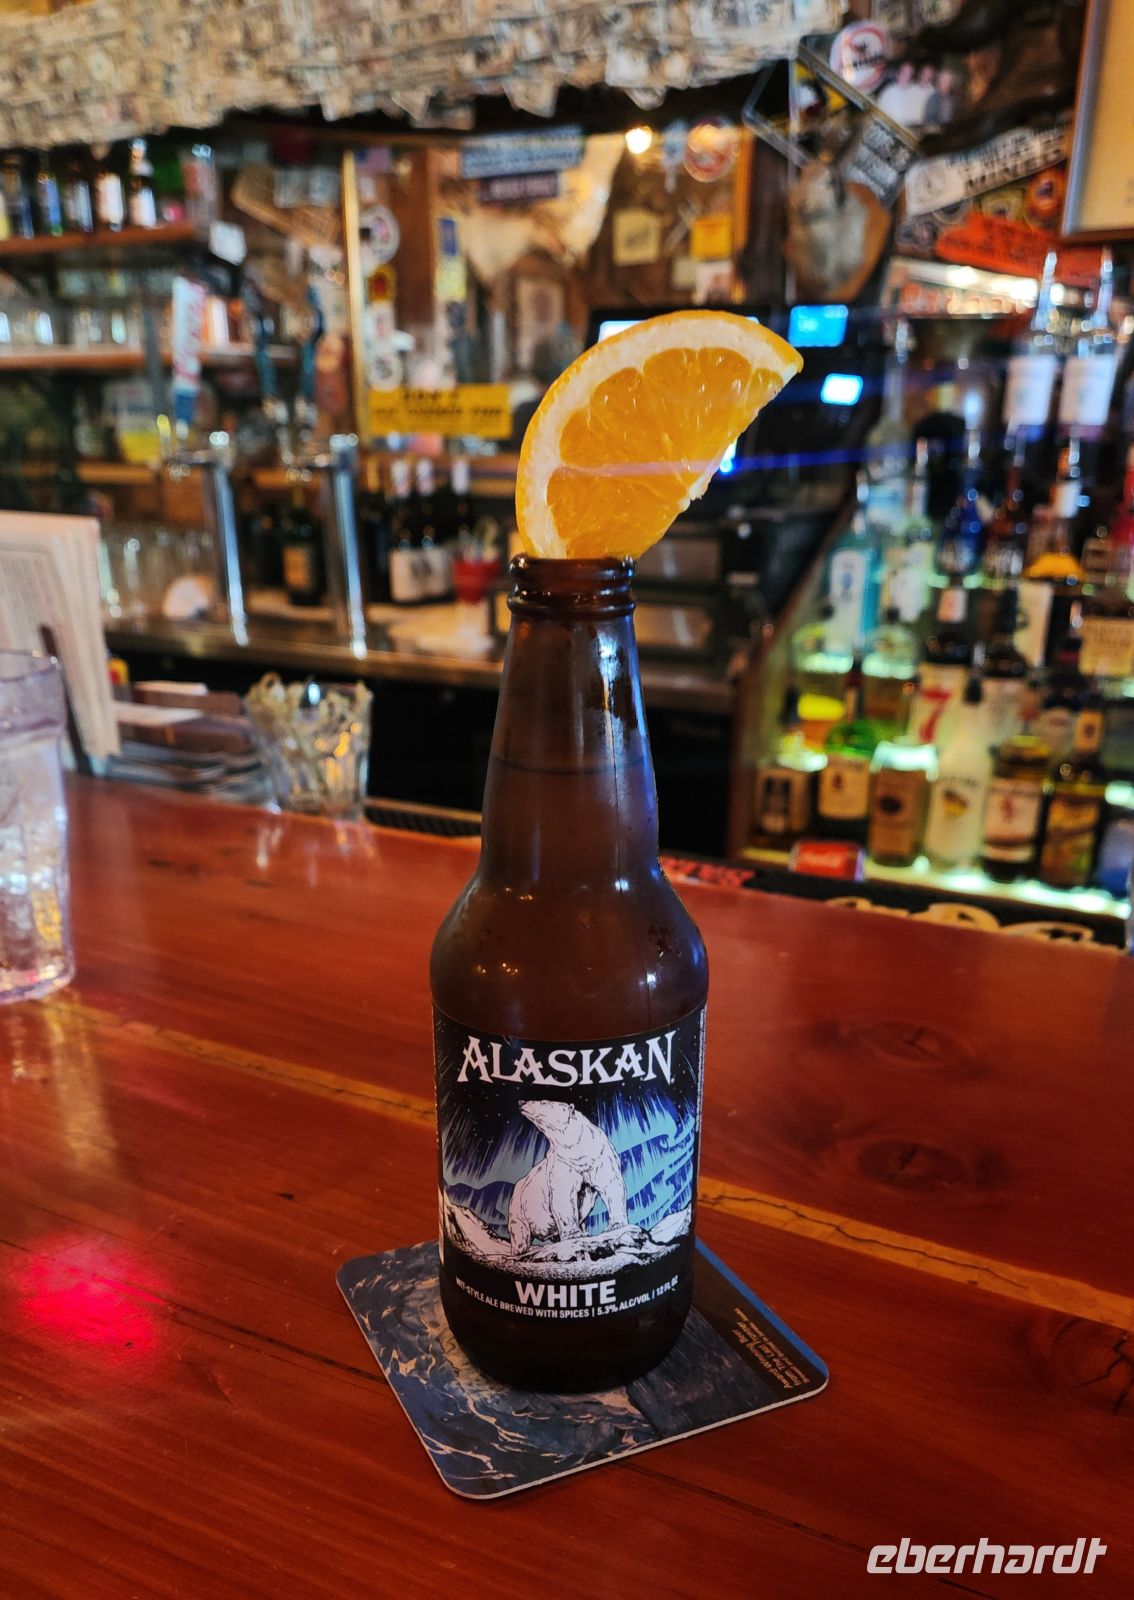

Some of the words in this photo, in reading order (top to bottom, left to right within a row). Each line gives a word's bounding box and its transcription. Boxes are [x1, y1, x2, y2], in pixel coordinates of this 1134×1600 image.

[456, 1030, 677, 1087] ALASKAN
[485, 1298, 499, 1308] ALE
[499, 1301, 534, 1316] BREWED
[534, 1309, 558, 1318] WITH
[558, 1308, 590, 1319] SPICES
[597, 1304, 618, 1316] 5.3%
[618, 1292, 651, 1311] ALC/VOL
[655, 1286, 664, 1296] 12
[514, 1279, 616, 1307] WHITE
